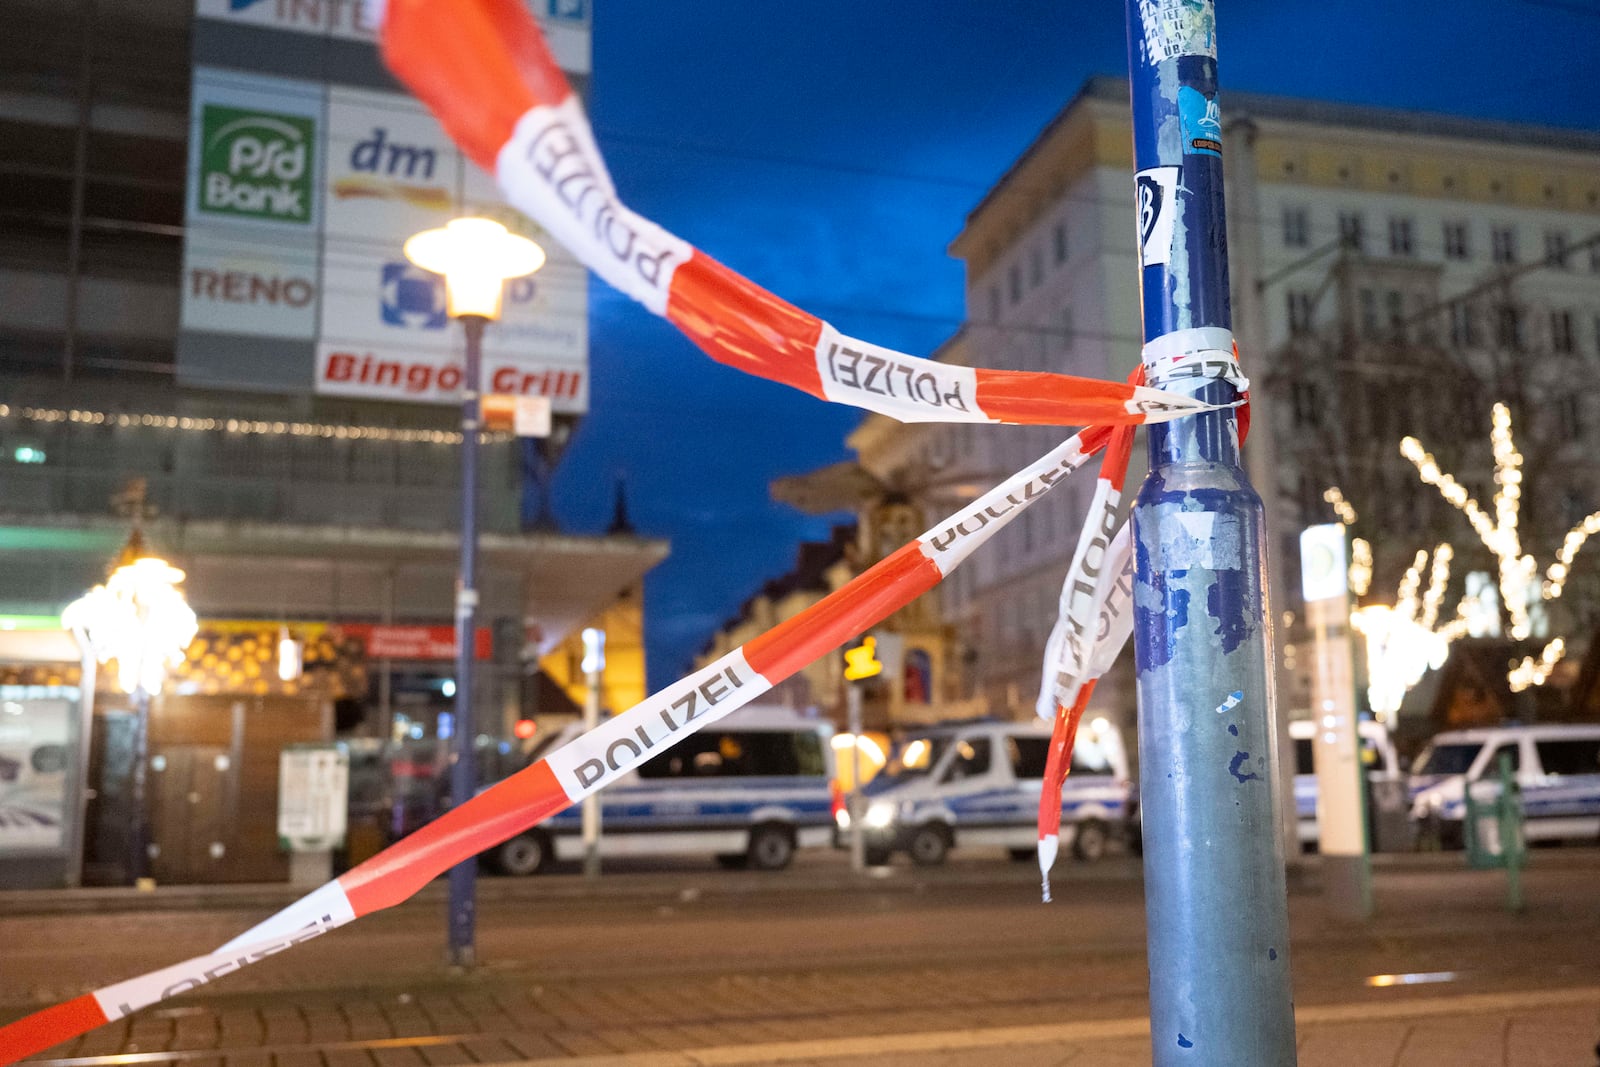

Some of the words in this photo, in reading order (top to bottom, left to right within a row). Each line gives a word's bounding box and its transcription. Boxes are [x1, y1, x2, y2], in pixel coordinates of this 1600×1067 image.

[351, 128, 437, 179] dm
[206, 172, 303, 217] Bank
[191, 268, 313, 309] RENO
[325, 352, 463, 393] Bingo
[492, 367, 581, 399] Grill
[827, 343, 969, 413] POLIZEI
[572, 665, 744, 790] POLIZEI
